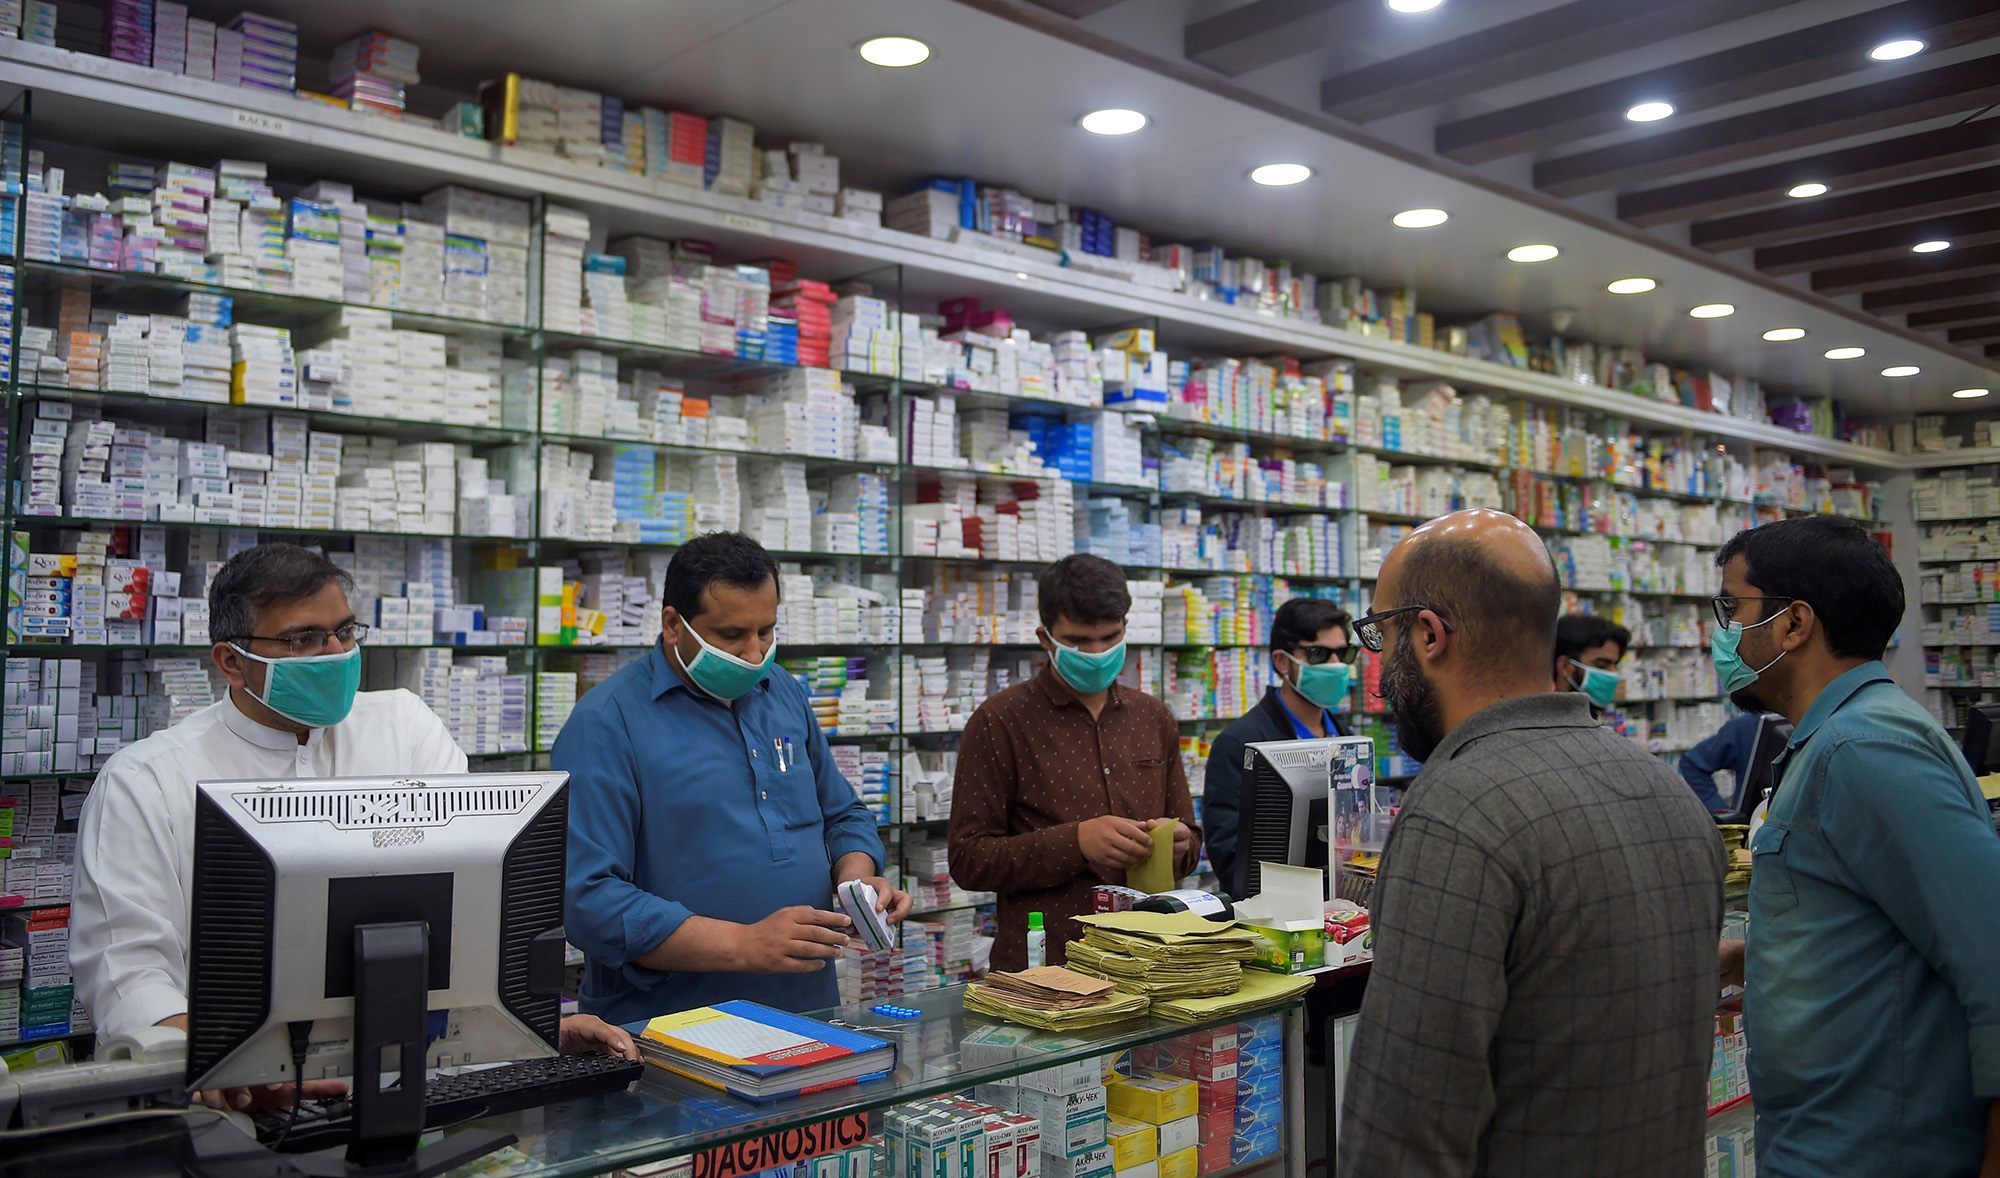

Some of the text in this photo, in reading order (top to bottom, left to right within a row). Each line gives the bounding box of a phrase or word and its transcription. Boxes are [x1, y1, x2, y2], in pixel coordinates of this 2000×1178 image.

[351, 796, 434, 821] DELL
[1239, 1057, 1256, 1067] Panadol
[1238, 1086, 1255, 1097] Panadol
[1240, 1113, 1256, 1124] Panadol
[692, 1113, 867, 1178] DIAGNOSTICS
[1236, 1143, 1252, 1154] Panadol
